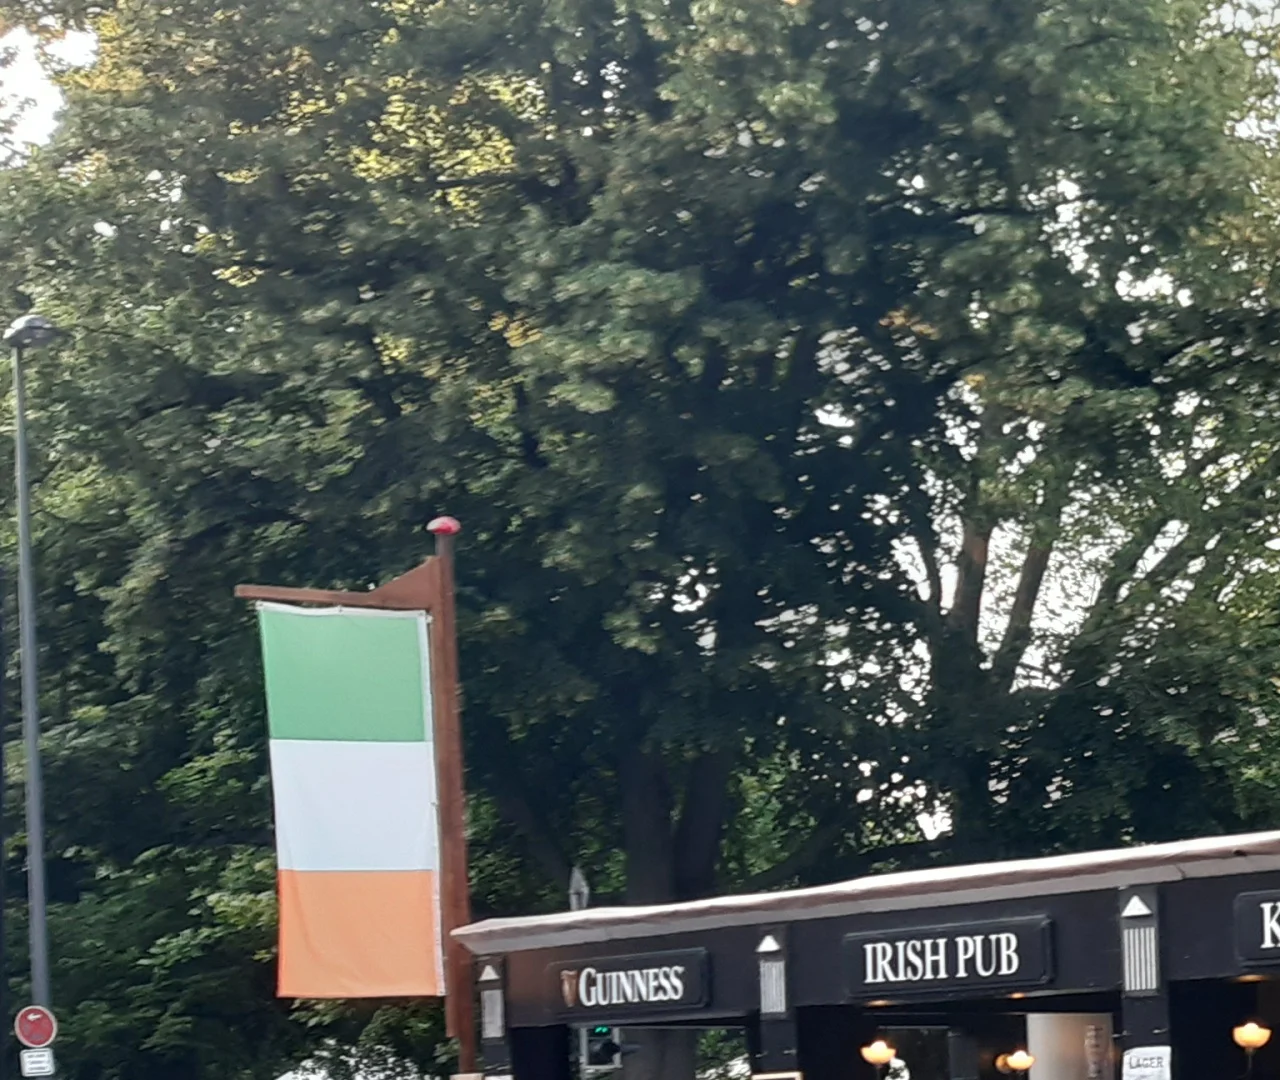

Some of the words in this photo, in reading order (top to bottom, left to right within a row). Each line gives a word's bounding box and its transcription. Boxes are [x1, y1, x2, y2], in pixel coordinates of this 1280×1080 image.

[863, 941, 949, 984] IRISH
[955, 932, 1019, 978] PUB
[579, 965, 685, 1007] GUINNESS
[1129, 1055, 1165, 1069] LAGER
